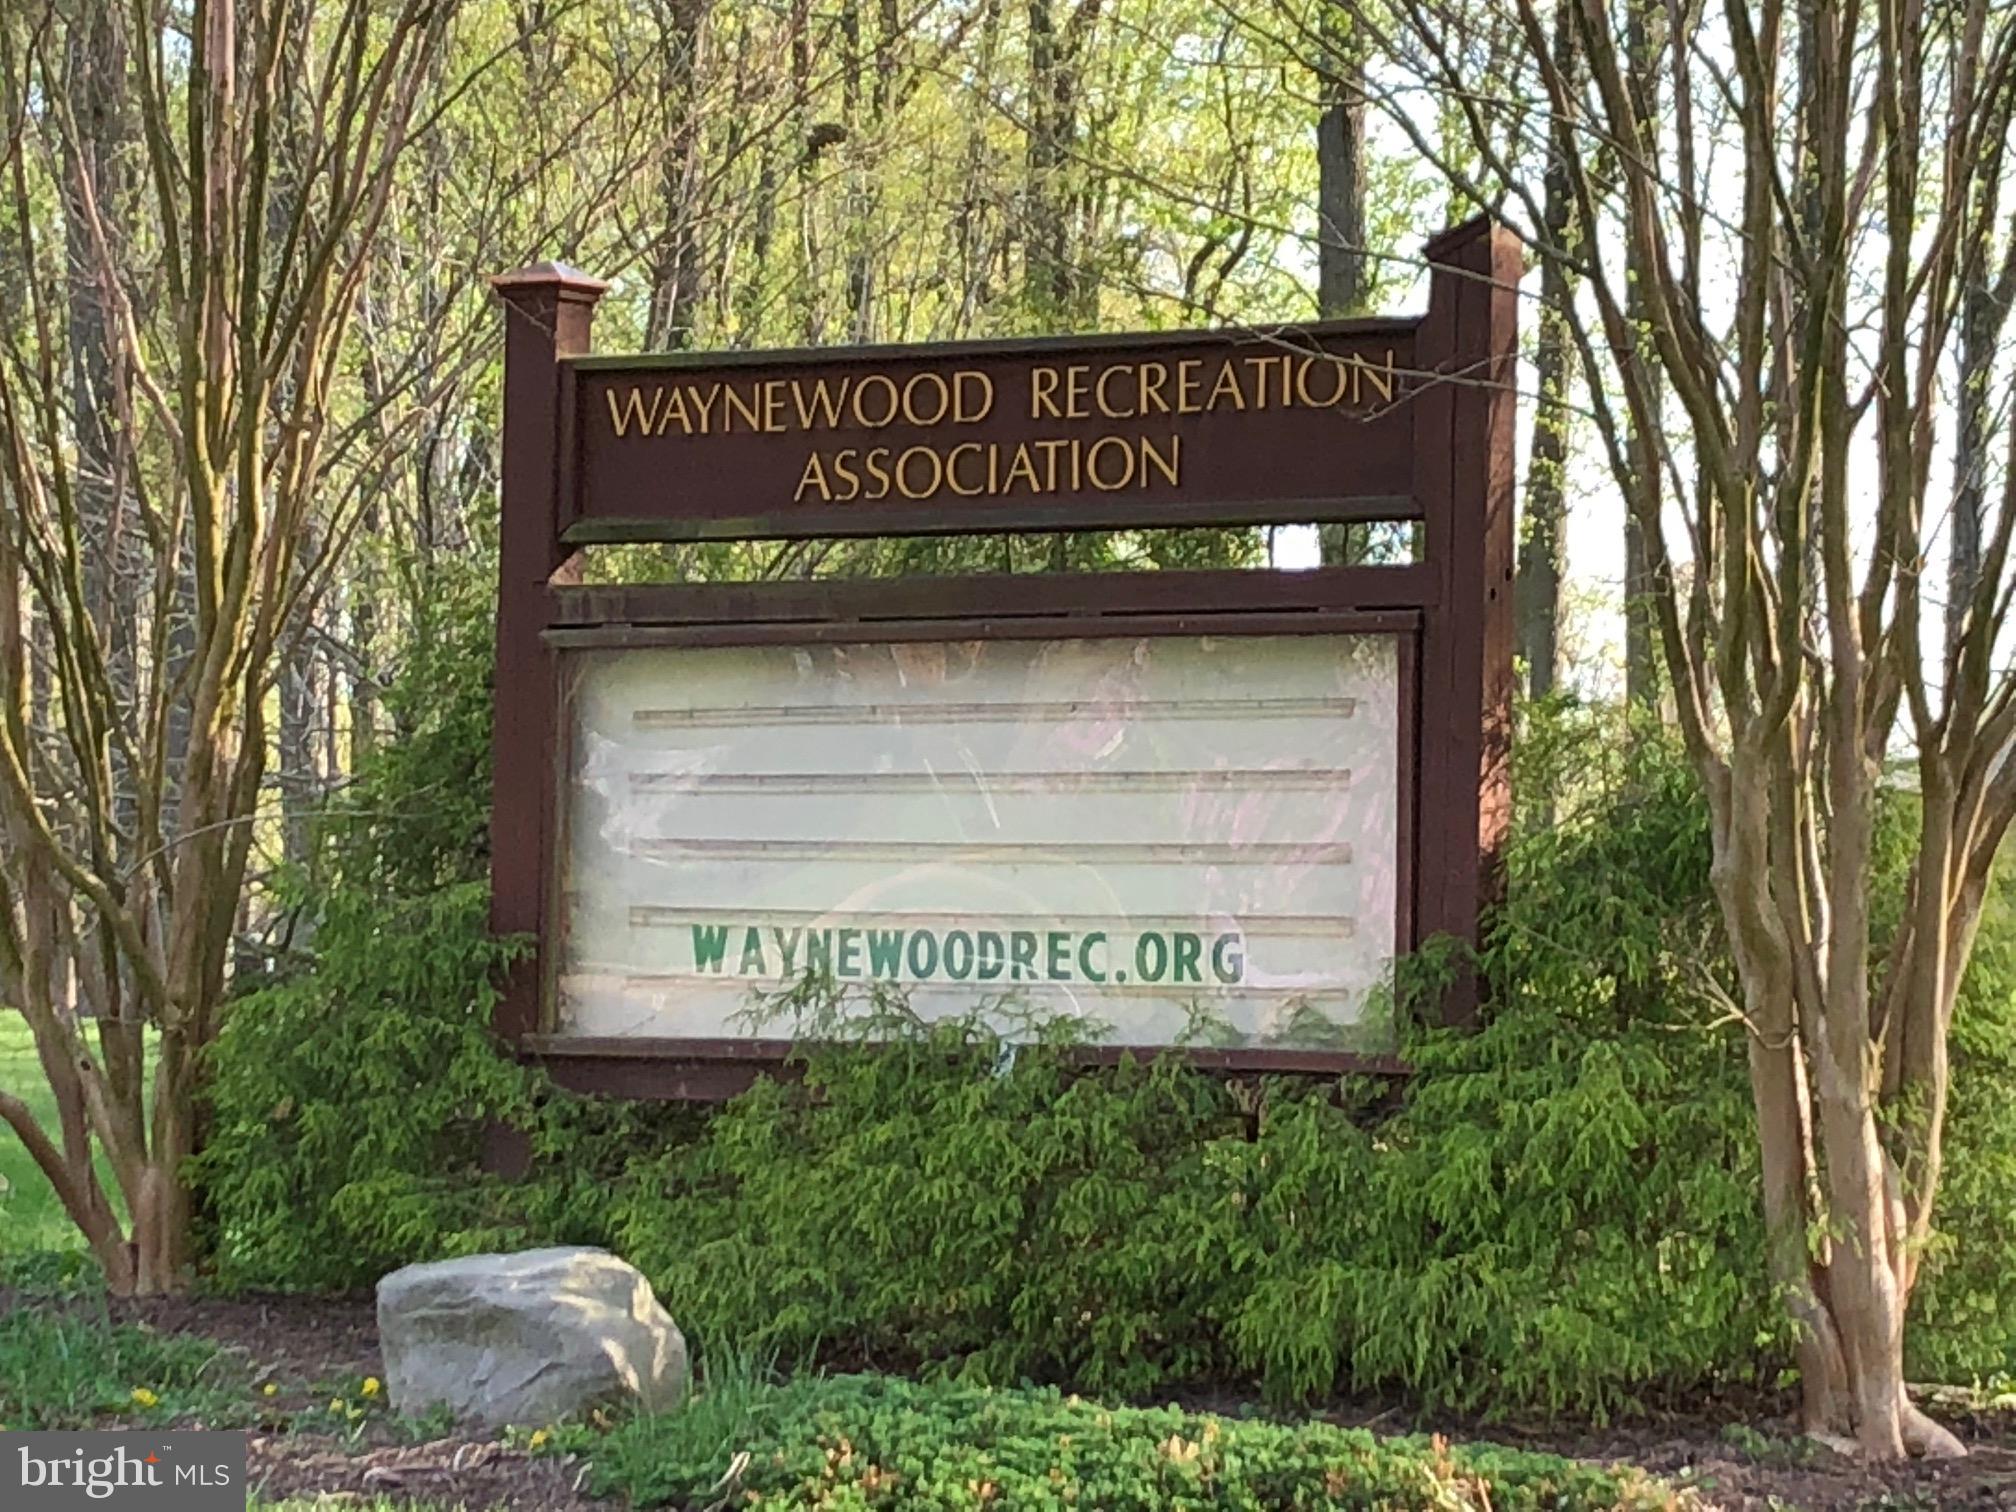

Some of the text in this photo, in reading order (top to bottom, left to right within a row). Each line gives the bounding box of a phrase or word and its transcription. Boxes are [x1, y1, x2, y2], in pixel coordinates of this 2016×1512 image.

[606, 349, 1396, 436] WAYNEWOOD RECREATION
[794, 435, 1181, 501] ASSOCIATION
[691, 923, 1245, 985] WAYNEWOODREC.ORG
